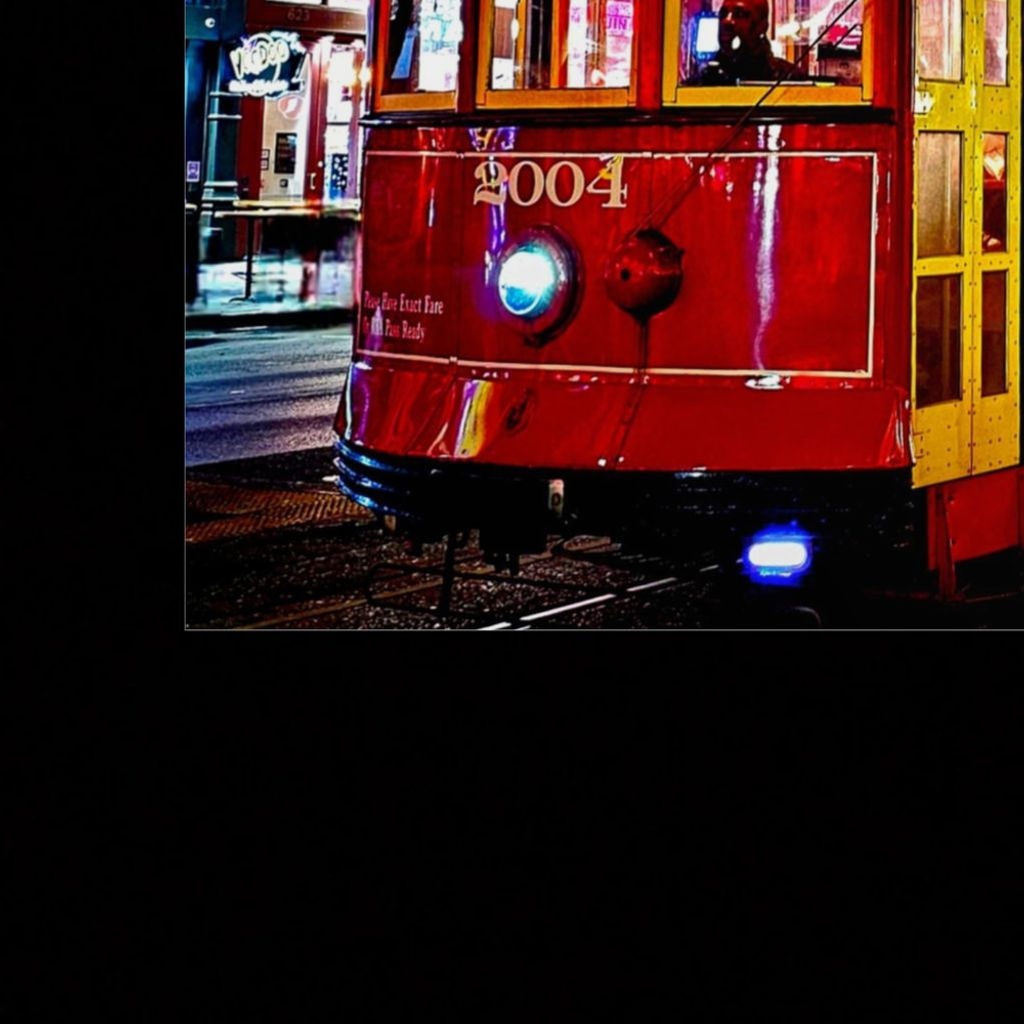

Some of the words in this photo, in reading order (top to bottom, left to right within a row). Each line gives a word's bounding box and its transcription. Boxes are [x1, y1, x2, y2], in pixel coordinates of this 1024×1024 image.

[287, 9, 311, 22] 623
[472, 156, 629, 208] 2004
[424, 294, 444, 315] Fare
[402, 320, 426, 344] Ready
